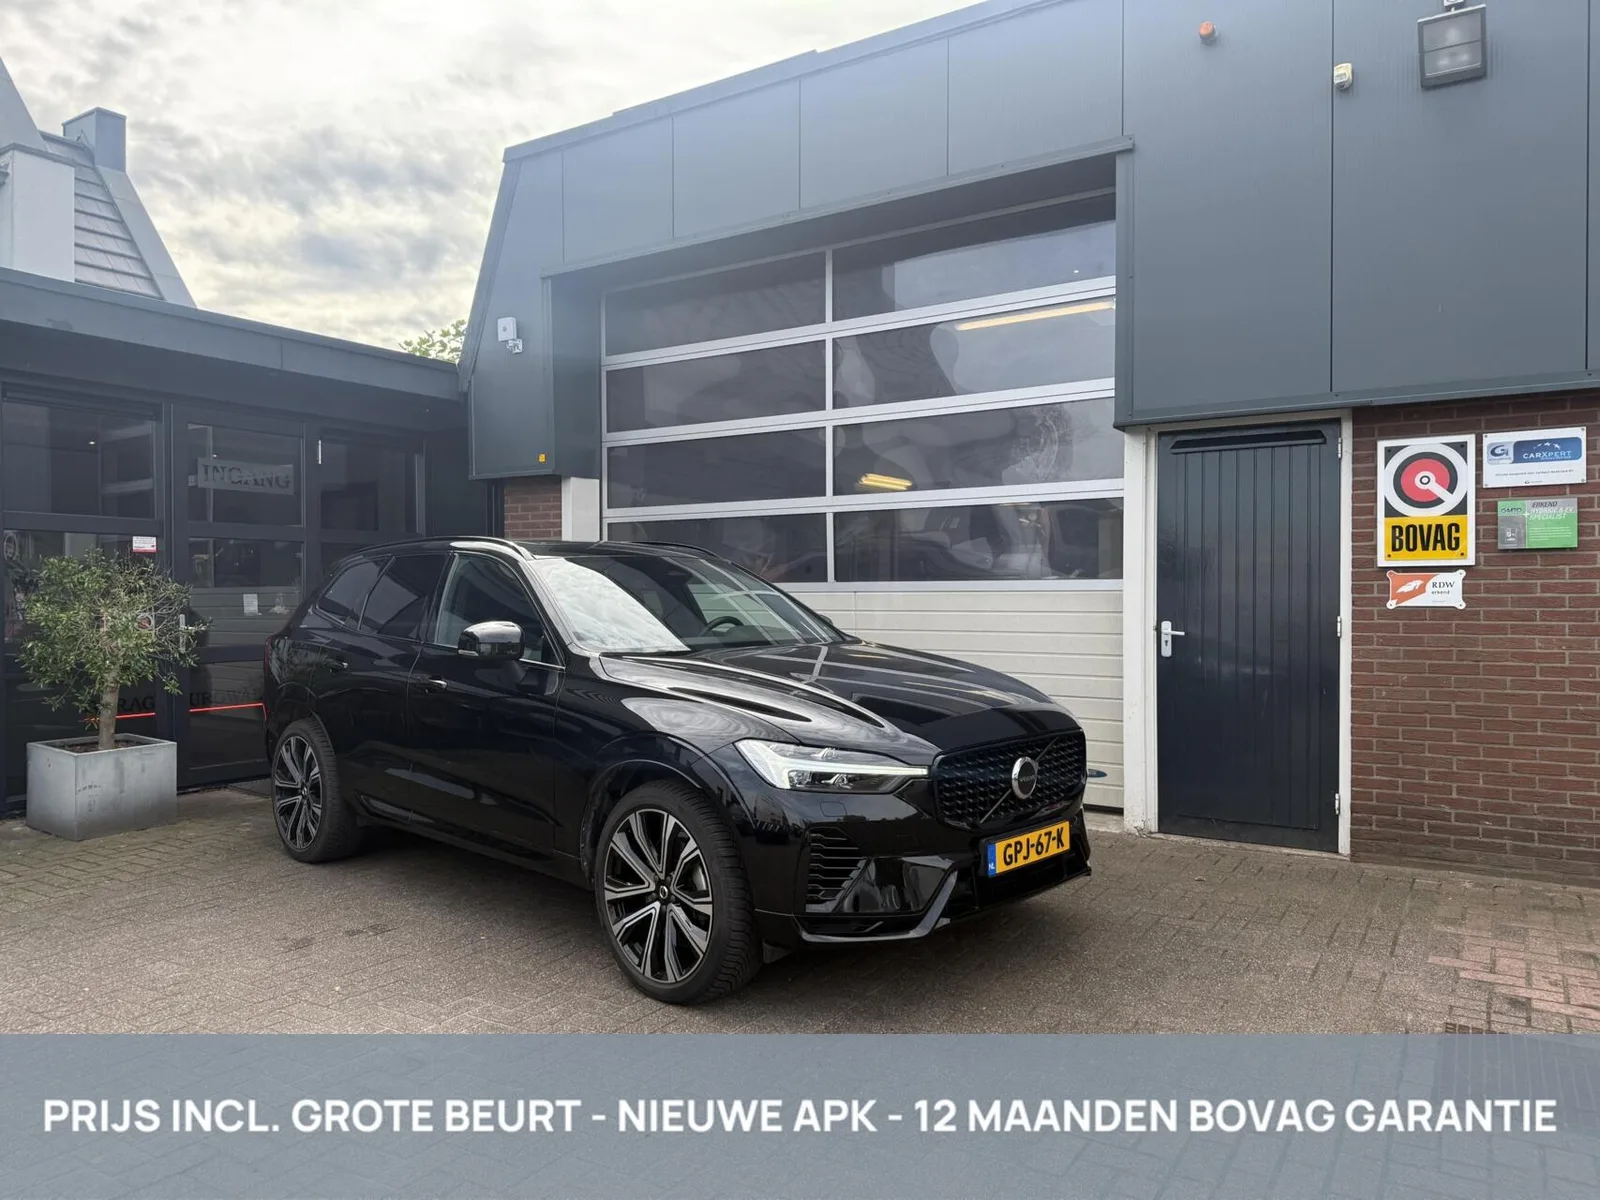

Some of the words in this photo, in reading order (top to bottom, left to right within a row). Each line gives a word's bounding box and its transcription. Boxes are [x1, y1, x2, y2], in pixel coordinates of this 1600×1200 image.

[1523, 450, 1572, 459] CARXPERT
[202, 464, 291, 489] INGANG
[1391, 523, 1460, 552] BOVAG
[1432, 581, 1455, 589] RDW
[1003, 827, 1065, 866] GPJ-67-K
